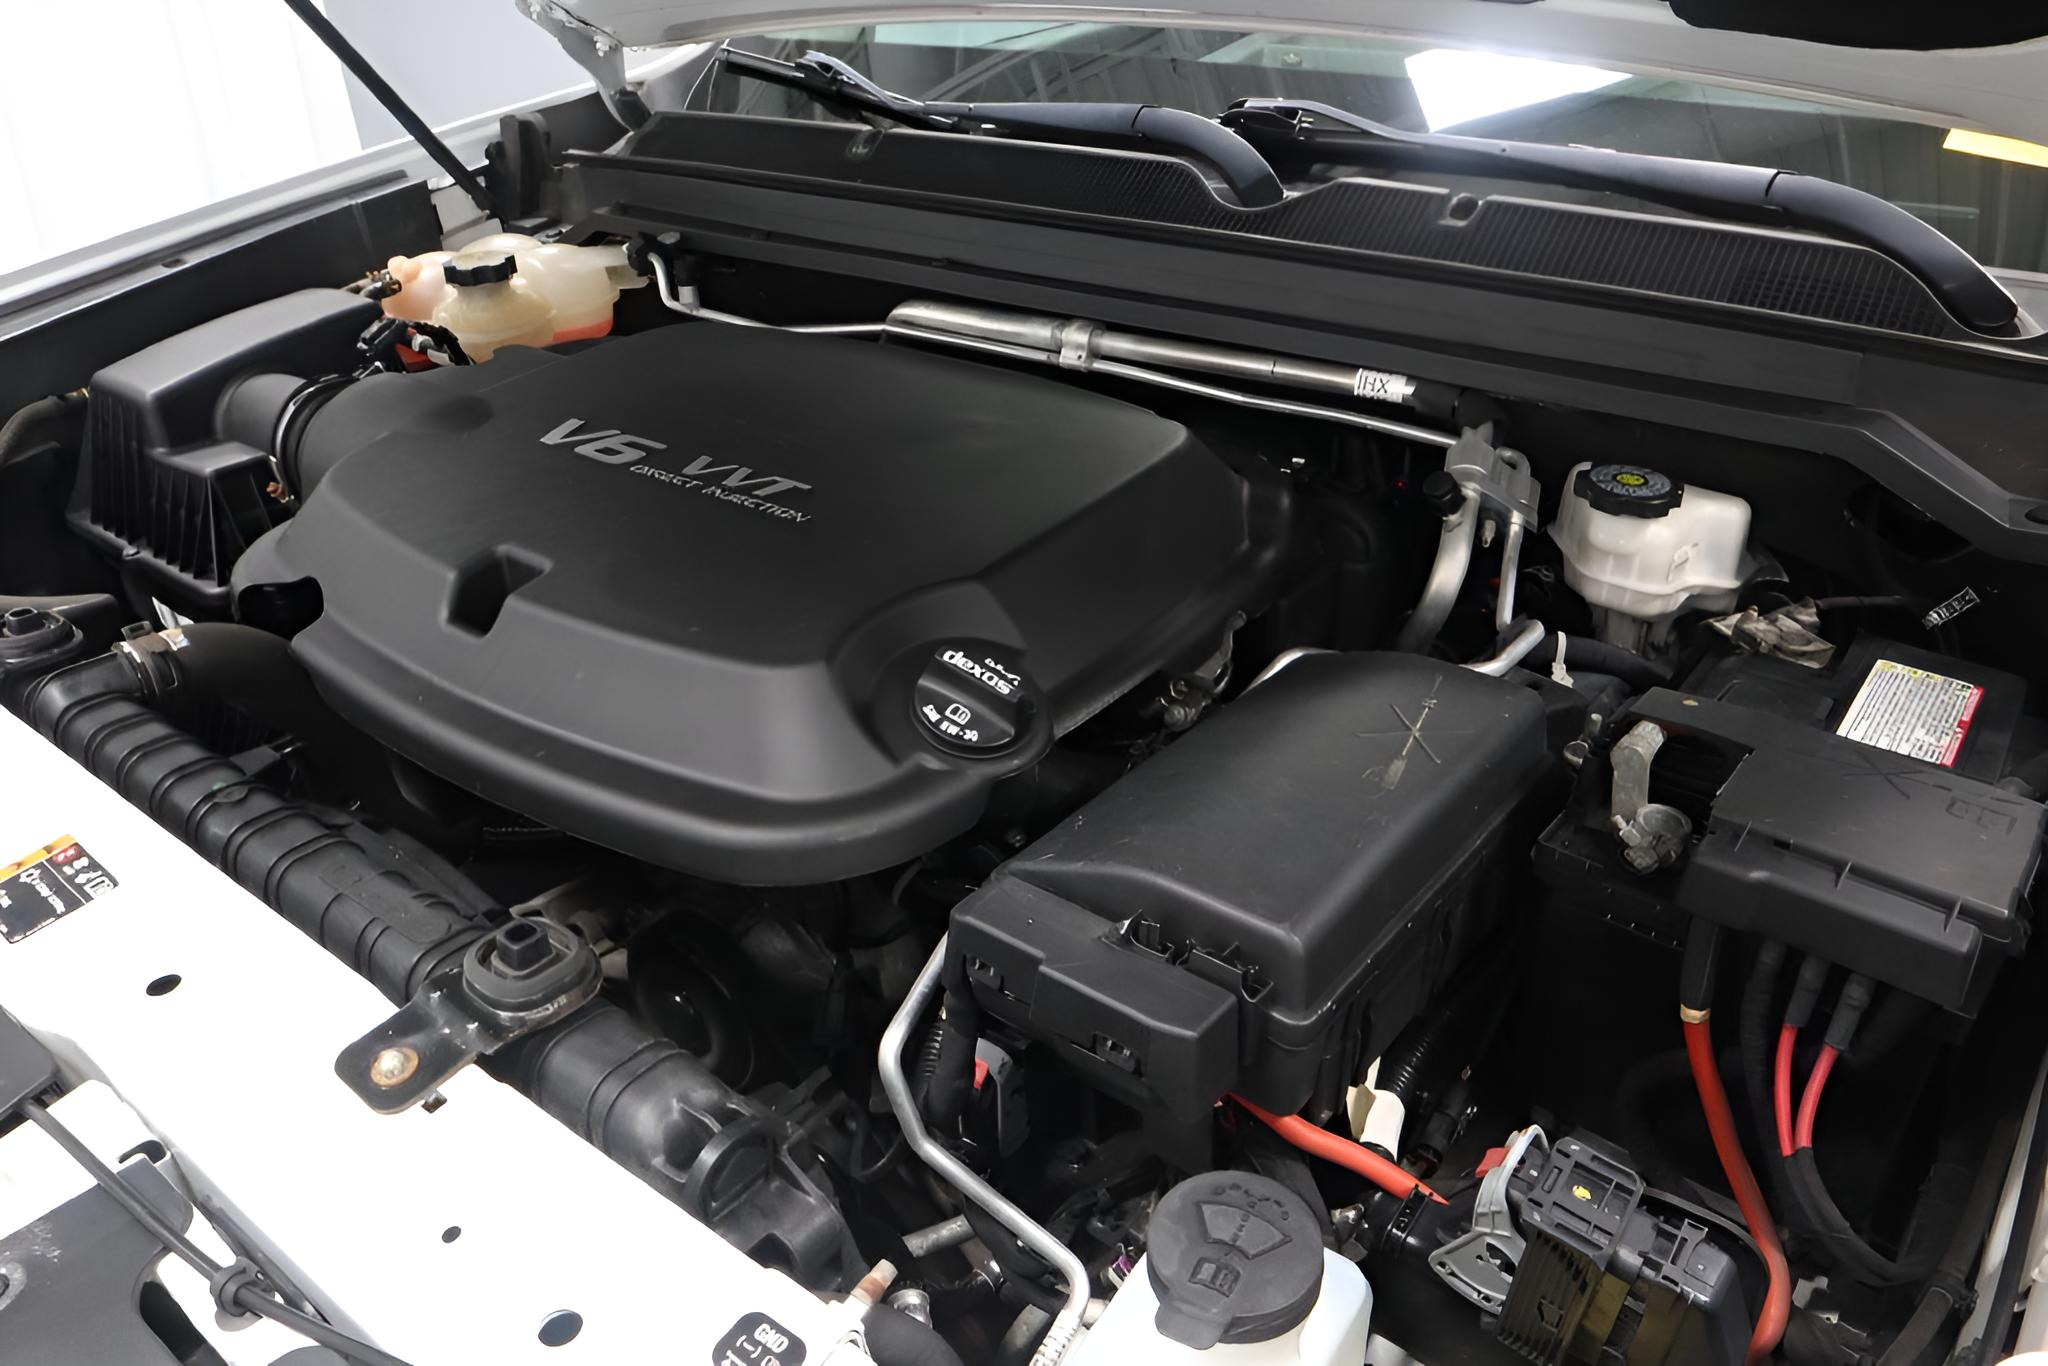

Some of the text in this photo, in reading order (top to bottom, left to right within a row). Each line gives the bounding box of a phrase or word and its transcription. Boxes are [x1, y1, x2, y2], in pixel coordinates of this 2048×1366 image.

[540, 418, 812, 496] V6 VVT
[943, 650, 1015, 694] dexos
